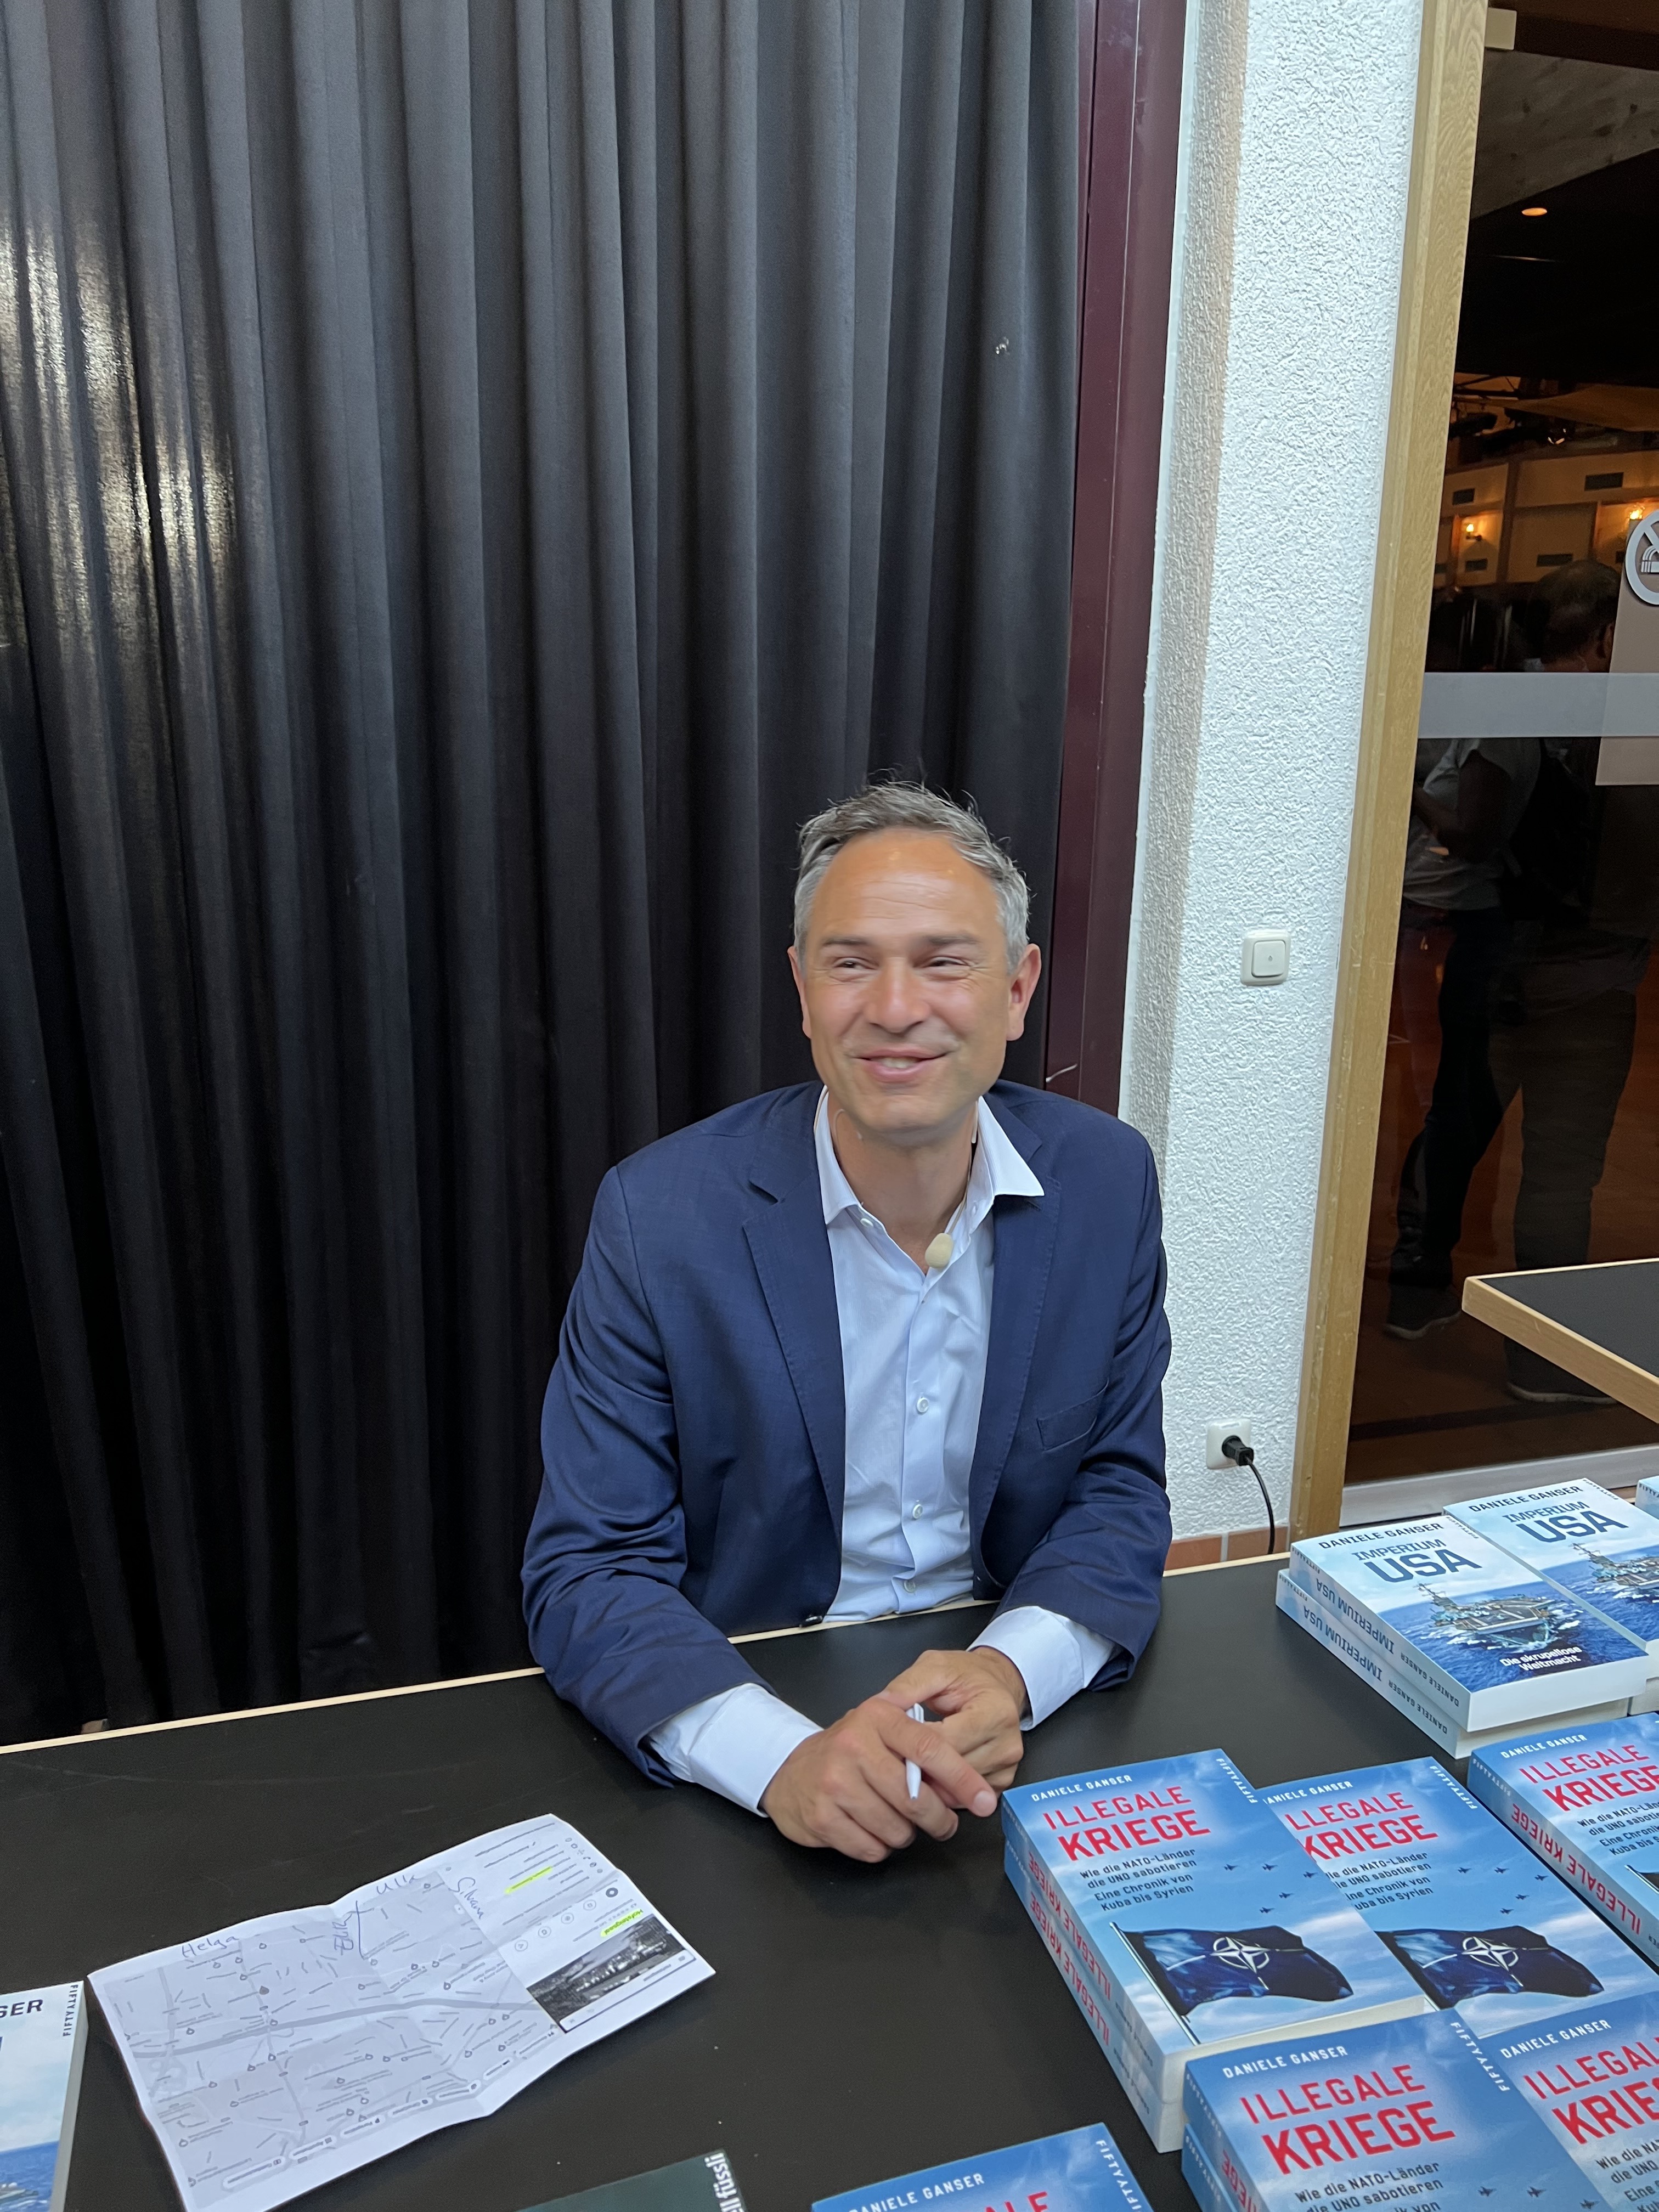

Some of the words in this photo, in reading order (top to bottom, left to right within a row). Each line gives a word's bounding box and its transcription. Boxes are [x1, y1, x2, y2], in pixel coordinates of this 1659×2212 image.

[1469, 1496, 1530, 1512] DANIELE
[1528, 1486, 1583, 1500] GANSER
[1502, 1501, 1590, 1523] IMPERIUM
[1318, 1532, 1384, 1549] DANIELE
[1384, 1522, 1444, 1537] GANSER
[1516, 1510, 1629, 1543] USA
[1351, 1539, 1447, 1561] IMPERIUM
[1363, 1549, 1483, 1583] USA
[1317, 1578, 1335, 1604] USA
[1304, 1605, 1323, 1630] USA
[1339, 1595, 1395, 1655] IMPERIUM
[1325, 1624, 1382, 1681] IMPERIUM
[1401, 1652, 1427, 1679] GANSER
[1499, 1658, 1521, 1667] Die
[1520, 1646, 1582, 1662] skrupellose
[1519, 1655, 1581, 1671] Weltmacht
[1388, 1679, 1415, 1707] GANSER
[1429, 1675, 1459, 1707] DANIELE
[1417, 1704, 1447, 1734] DANIELE
[1500, 1742, 1546, 1758] DANIELE
[1546, 1734, 1588, 1748] GANSER
[1519, 1745, 1650, 1784] ILLEGALE
[1031, 1784, 1083, 1802] DANIELE
[1087, 1775, 1132, 1790] GANSER
[1311, 1781, 1353, 1795] GANSER
[1043, 1786, 1192, 1830] ILLEGALE
[1285, 1792, 1414, 1830] LLEGALE
[1577, 1819, 1596, 1827] Wie
[1598, 1814, 1613, 1822] die
[1614, 1802, 1659, 1818] NATO-Län
[1057, 1809, 1211, 1861] KRIEGE
[1511, 1803, 1564, 1863] KRIEGE
[1589, 1827, 1605, 1836] die
[1605, 1820, 1626, 1831] UNO
[1626, 1813, 1659, 1825] sabotie
[1600, 1836, 1624, 1847] Eine
[1610, 1844, 1638, 1855] Kuba
[1635, 1839, 1654, 1848] bis
[1080, 1870, 1100, 1879] Wie
[1103, 1865, 1121, 1874] die
[1122, 1849, 1196, 1869] NATO-Länder
[1087, 1879, 1106, 1888] die
[1108, 1872, 1130, 1883] UNO
[1133, 1859, 1197, 1877] sabotieren
[1333, 1880, 1348, 1889] ie
[1348, 1875, 1370, 1886] UNO
[1372, 1863, 1432, 1880] sabotieren
[1342, 1867, 1359, 1876] die
[1359, 1852, 1428, 1871] NATO-Länder
[1029, 1852, 1061, 1917] KRIEGE
[1094, 1889, 1121, 1901] Eine
[1122, 1878, 1170, 1894] Chronik
[1170, 1874, 1193, 1883] von
[1101, 1899, 1132, 1911] Kuba
[1133, 1894, 1152, 1904] bis
[1154, 1885, 1194, 1898] Syrien
[1345, 1892, 1364, 1901] ine
[1365, 1880, 1409, 1895] Chronik
[1409, 1876, 1431, 1886] von
[1354, 1900, 1377, 1910] uba
[1376, 1895, 1395, 1904] bis
[1396, 1887, 1434, 1900] Syrien
[1567, 1854, 1641, 1935] ILLEGALE
[1030, 1891, 1062, 1959] KRIEGE
[182, 1935, 239, 1959] Helga
[1063, 1909, 1110, 2001] ILLEGALE
[1064, 1951, 1109, 2045] ILLEGALE
[1500, 2033, 1559, 2058] DANIELE
[1559, 2019, 1612, 2040] GANSER
[1222, 2056, 1287, 2079] DANIELE
[1290, 2046, 1348, 2065] GANSER
[1523, 2037, 1659, 2100] ILLEGAL
[1240, 2064, 1426, 2124] ILLEGALE
[1551, 2077, 1659, 2145] KRIE
[1262, 2101, 1456, 2175] KRIEGE
[1595, 2156, 1621, 2169] Wie
[1622, 2148, 1643, 2162] die
[1611, 2170, 1632, 2183] die
[1630, 2160, 1658, 2176] UNO
[704, 2152, 737, 2199] füssli
[1295, 2188, 1319, 2203] Wie
[1324, 2183, 1347, 2197] die
[1348, 2162, 1440, 2190] NATO-Länder
[849, 2191, 918, 2212] ANIELE
[922, 2173, 985, 2199] GANSER
[1331, 2196, 1361, 2211] UNO
[1363, 2179, 1444, 2204] sabotieren
[1624, 2185, 1656, 2202] Eine
